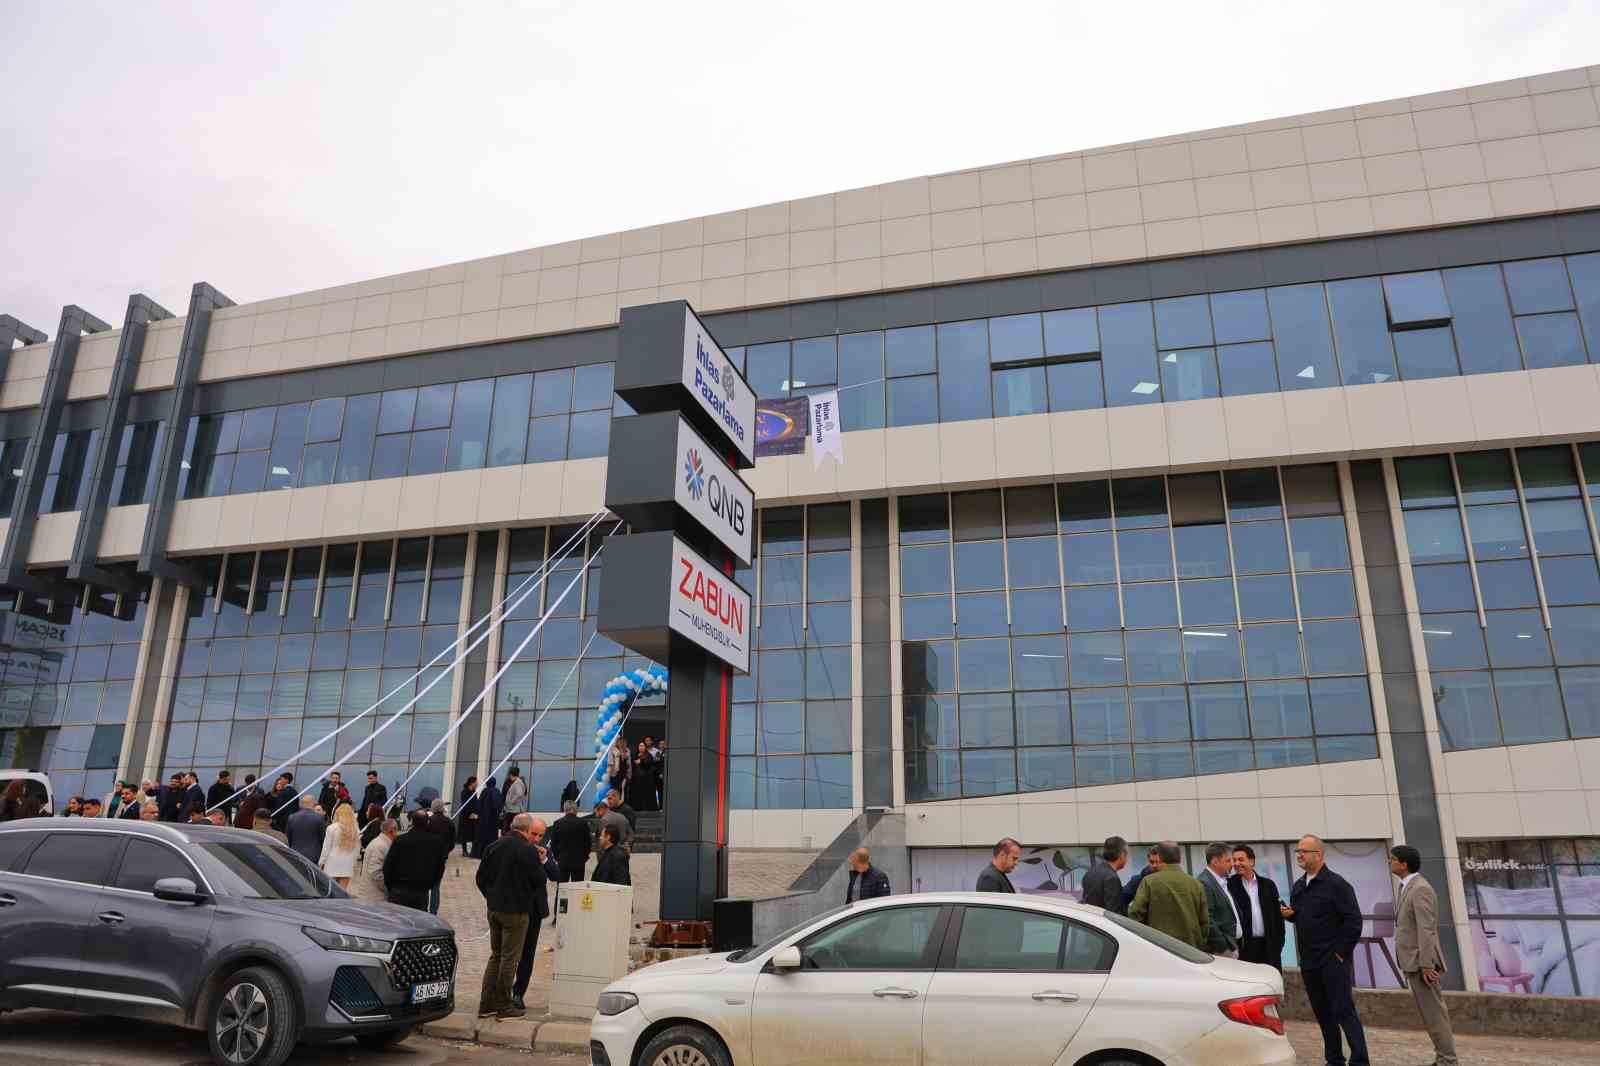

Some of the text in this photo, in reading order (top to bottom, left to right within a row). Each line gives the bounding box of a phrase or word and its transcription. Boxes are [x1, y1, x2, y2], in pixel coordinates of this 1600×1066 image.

[696, 333, 720, 385] İhlas
[695, 366, 745, 441] Pazarlama
[708, 474, 745, 536] QNB
[679, 557, 744, 635] ZABUN
[1464, 857, 1521, 870] Özdilek
